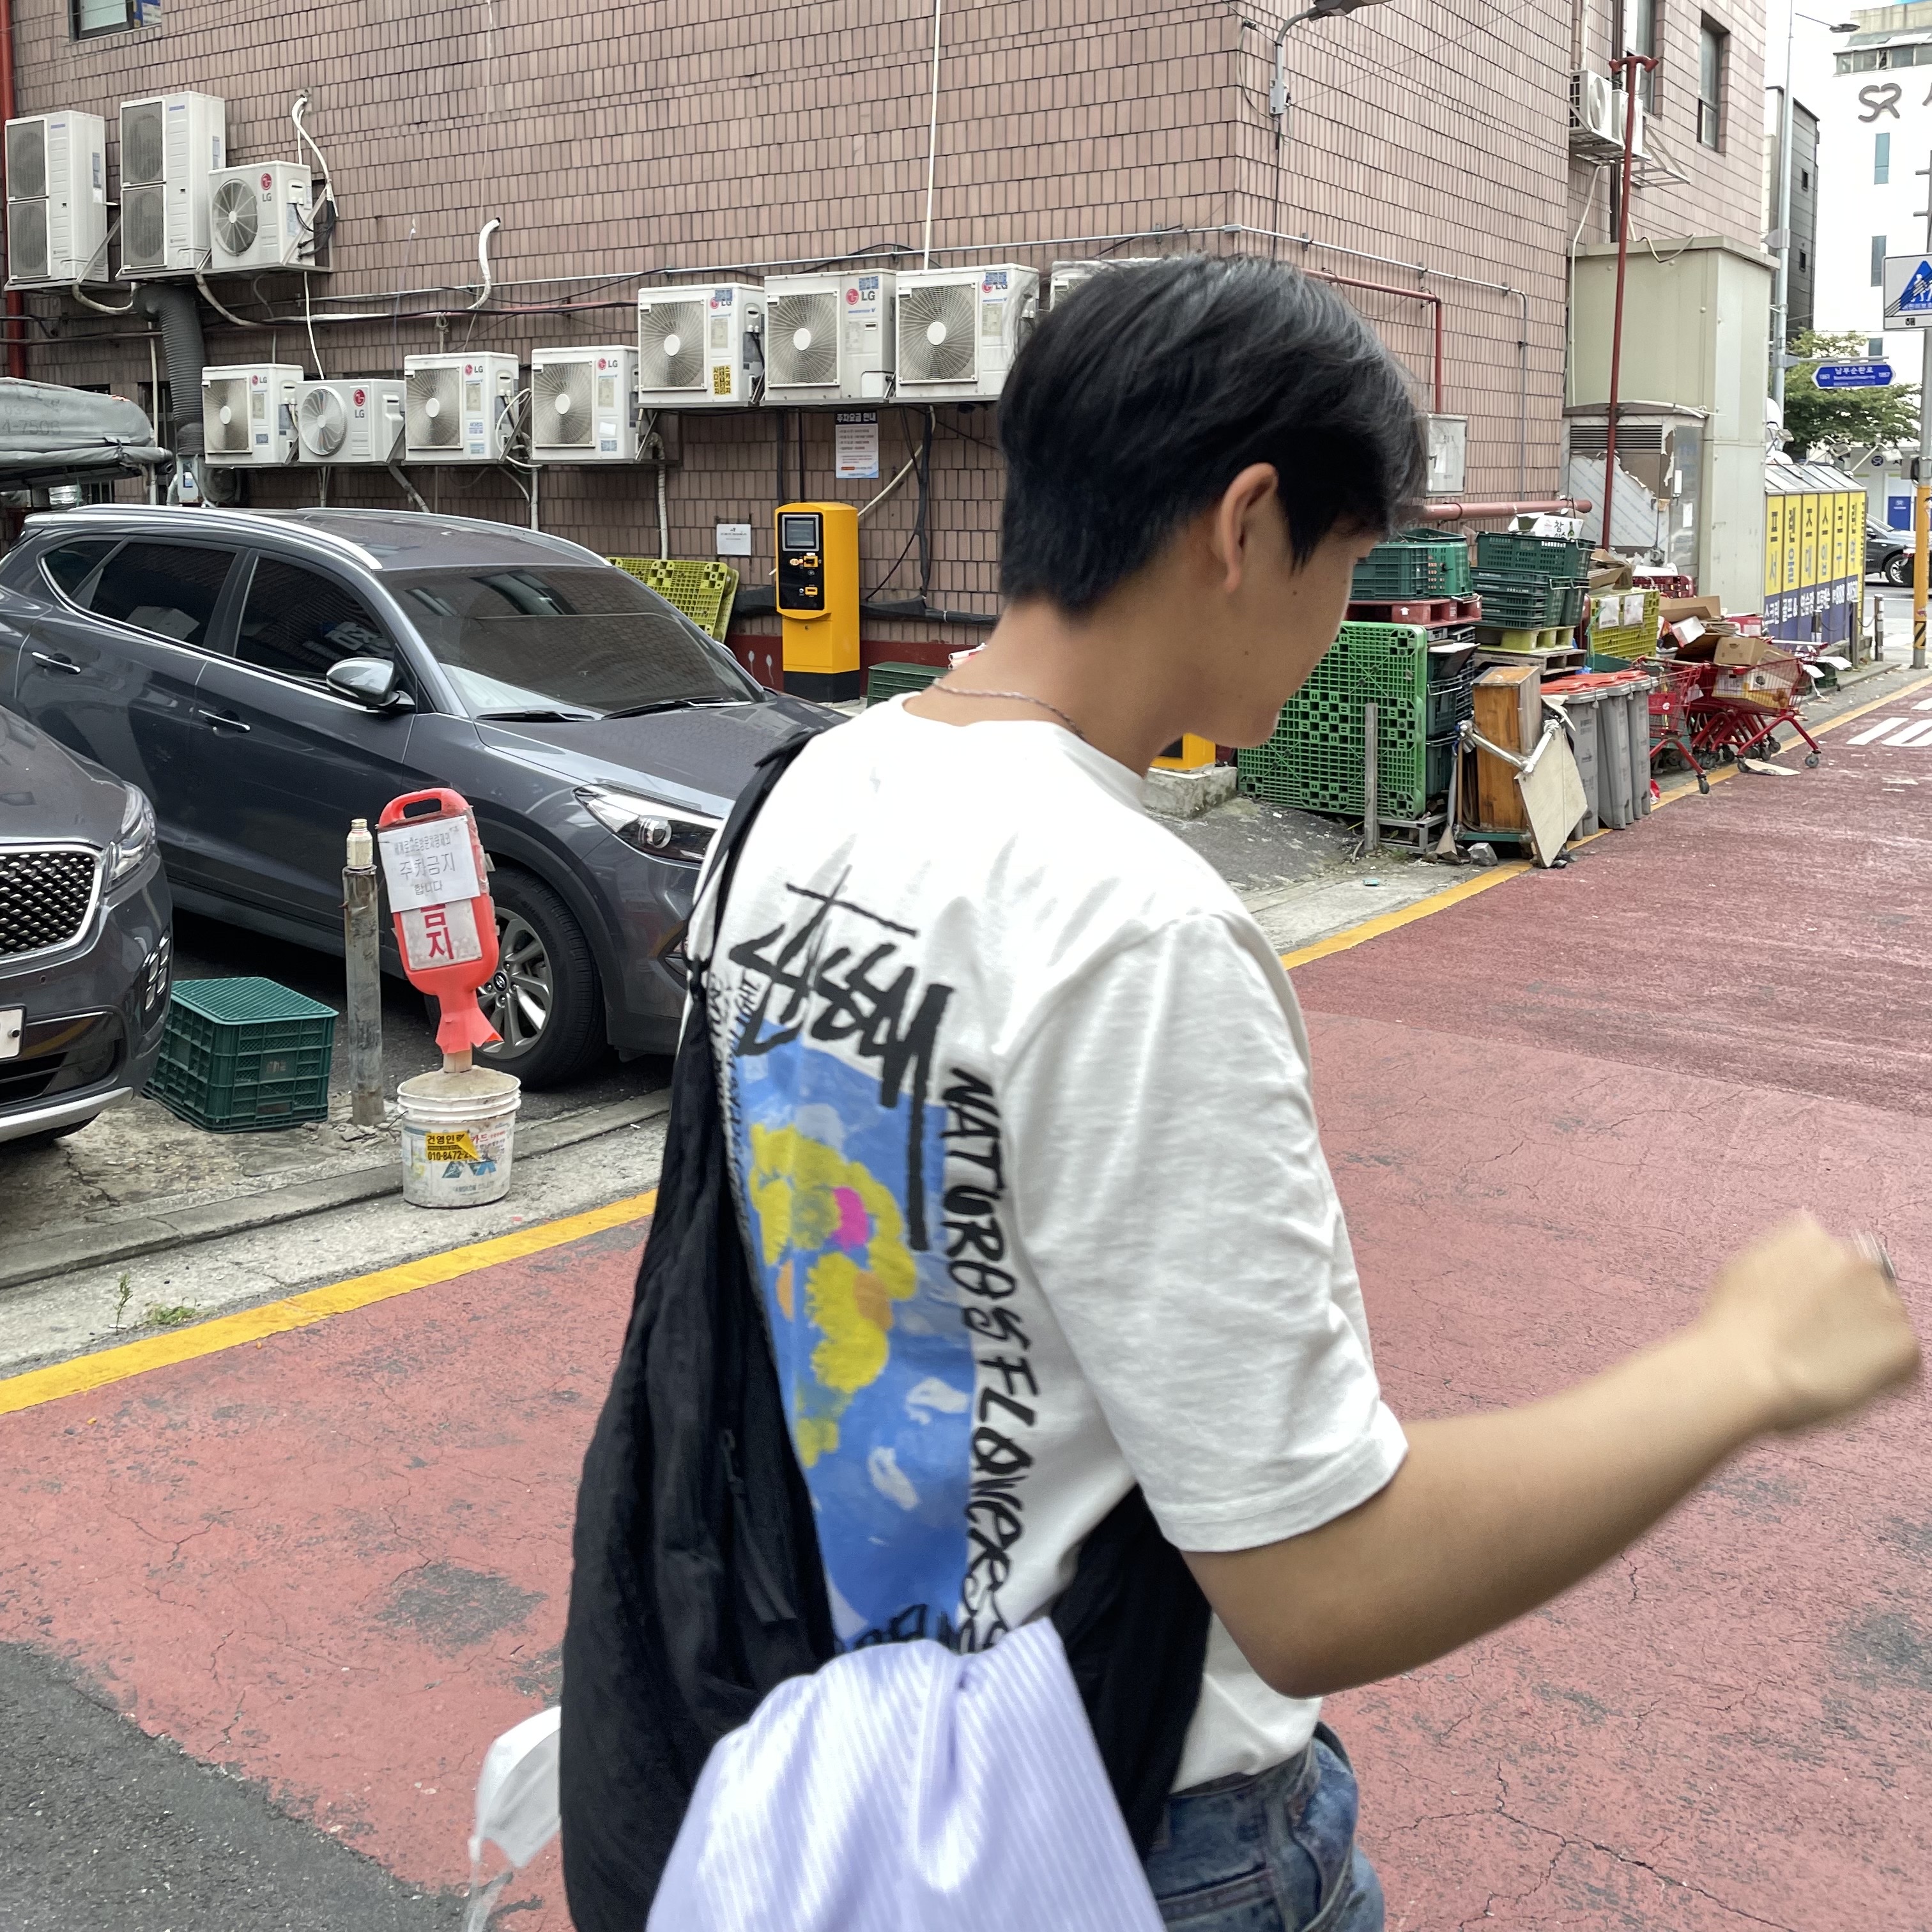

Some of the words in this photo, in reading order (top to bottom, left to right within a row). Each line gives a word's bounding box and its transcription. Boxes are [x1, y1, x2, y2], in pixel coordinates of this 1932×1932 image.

[262, 192, 272, 202] LG
[861, 290, 875, 302] LG
[473, 365, 484, 374] LG
[608, 360, 618, 369] LG
[1834, 366, 1874, 375] 남부순환로
[355, 410, 365, 418] LG
[836, 413, 862, 423] 주차요금
[399, 852, 456, 881] 주차금지
[413, 880, 443, 896] 합니다
